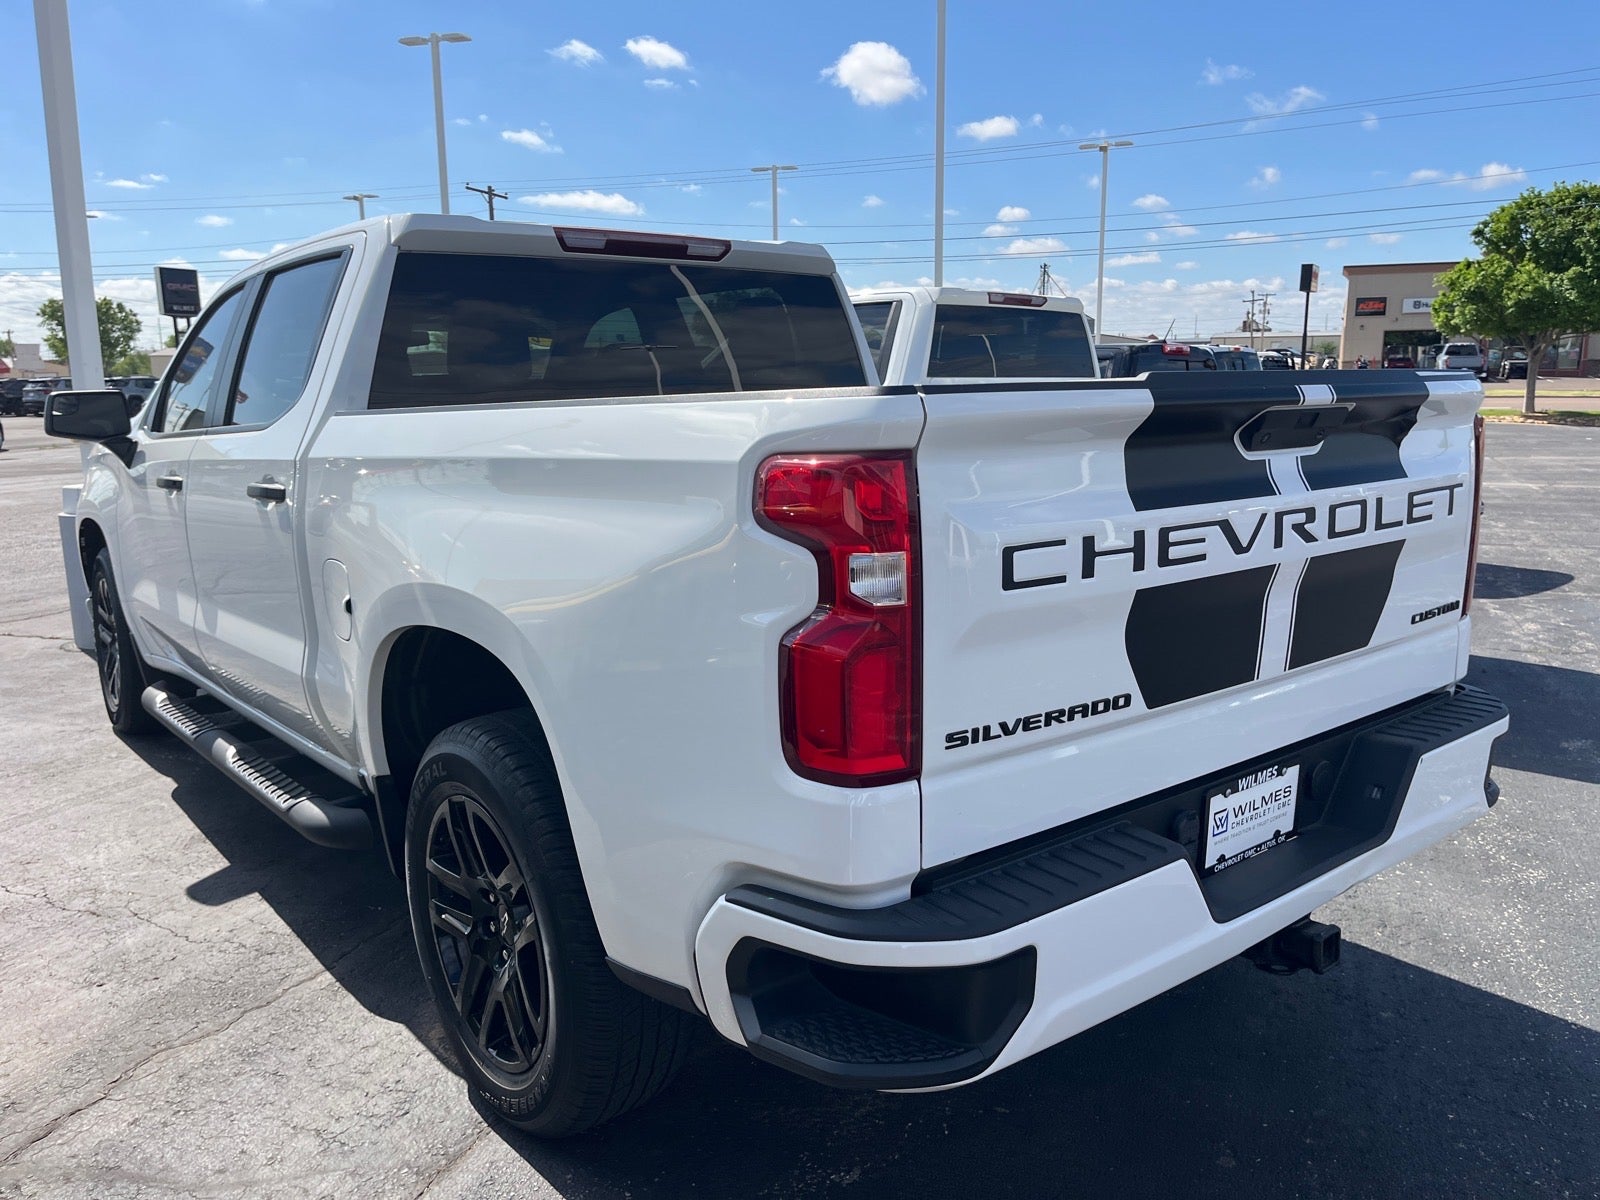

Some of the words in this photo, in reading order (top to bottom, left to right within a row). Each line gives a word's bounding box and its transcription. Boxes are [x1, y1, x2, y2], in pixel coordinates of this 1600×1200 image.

[1001, 483, 1464, 591] CHEVROLET
[1411, 600, 1460, 625] CUSTOM
[945, 693, 1132, 750] SILVERADO
[1238, 765, 1279, 792] WILMES
[1231, 807, 1271, 830] CHEVROLET
[1277, 798, 1292, 811] GMC
[1232, 785, 1293, 819] WILMES
[1214, 854, 1244, 873] CHEVROLET
[1244, 847, 1257, 859] GMC
[1277, 834, 1287, 844] OK
